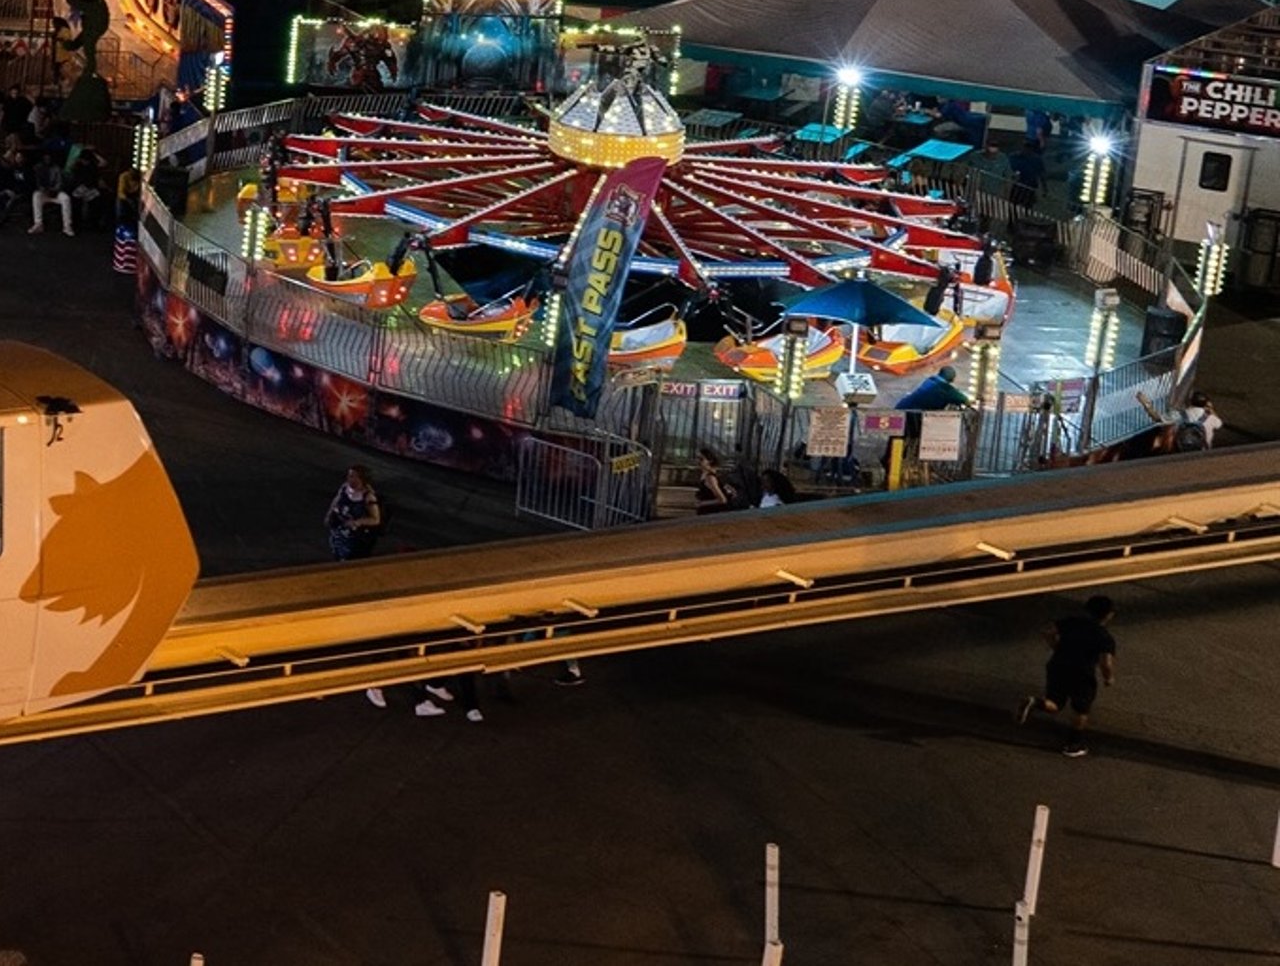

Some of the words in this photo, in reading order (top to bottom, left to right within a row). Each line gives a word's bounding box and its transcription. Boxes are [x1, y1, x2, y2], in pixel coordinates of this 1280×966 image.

[1182, 81, 1201, 94] THE
[1206, 81, 1277, 107] CHILI
[582, 227, 624, 316] PASS
[571, 316, 598, 407] FAST
[662, 381, 698, 395] EXIT
[703, 383, 737, 397] EXIT
